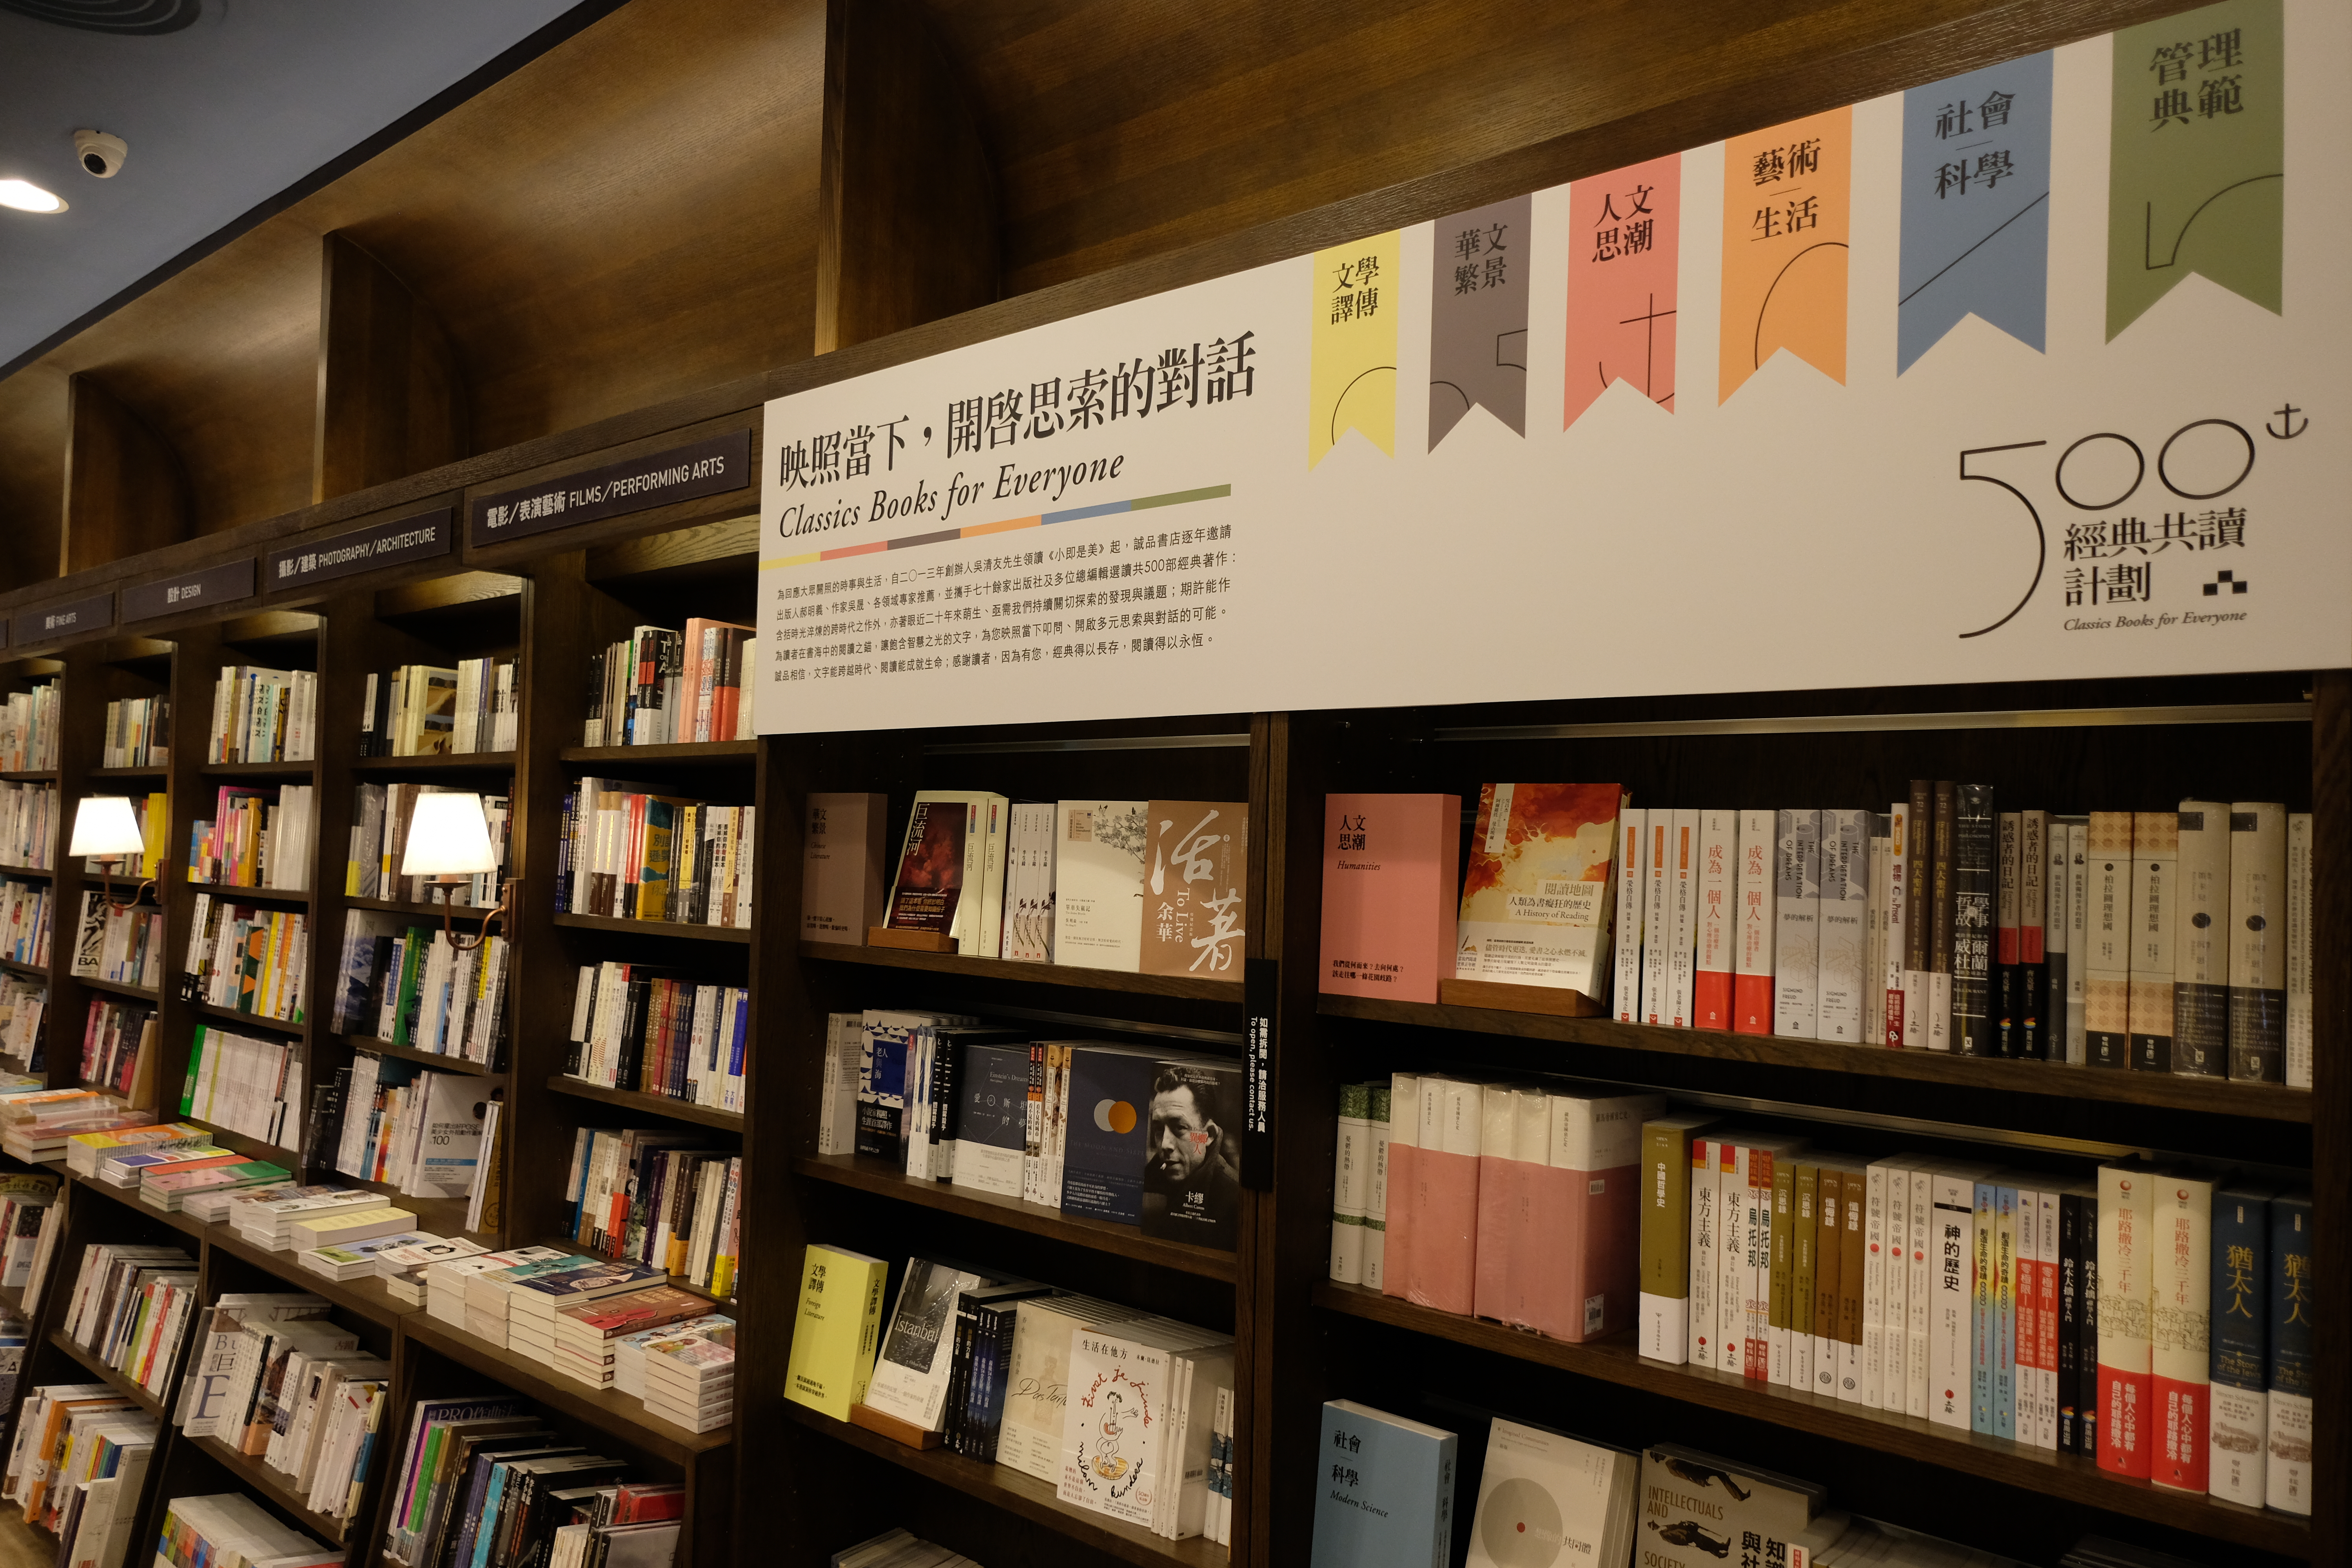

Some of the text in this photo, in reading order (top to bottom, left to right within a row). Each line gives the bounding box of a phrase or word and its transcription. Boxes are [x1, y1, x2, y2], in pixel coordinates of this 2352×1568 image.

[2149, 27, 2243, 86] 管理
[1935, 91, 2016, 140] 社會
[2149, 74, 2244, 132] 典範
[1753, 137, 1821, 187] 藝術
[1934, 149, 2014, 200] 科學
[1594, 185, 1654, 227] 人文
[1751, 196, 1819, 242] 生活
[1455, 223, 1508, 263] 華文
[1592, 219, 1654, 263] 思潮
[1332, 256, 1380, 293] 文學
[1454, 256, 1507, 296] 繁景
[1331, 288, 1379, 325] 譯傳
[570, 464, 689, 509] FILMS/PERFORMING
[692, 456, 724, 480] ARTS
[779, 453, 1125, 538] Classics Books for Everyone
[318, 526, 436, 568] PHOTOGRAPHY/ARCHITECTURE
[1959, 419, 2256, 639] 500
[2063, 507, 2247, 562] 經典共讀
[181, 584, 201, 599] DESIGN
[2063, 562, 2152, 607] 計劃
[66, 612, 76, 624] ARTS
[2063, 610, 2247, 631] Classics Books for Everyone
[906, 803, 930, 856] 巨流河
[1338, 833, 1365, 851] 思潮
[1339, 815, 1366, 831] 人文
[987, 843, 995, 872] 巨流河
[1786, 840, 1793, 851] OF
[2002, 821, 2014, 889] 誘惑者的日記
[2026, 818, 2038, 887] 誘惑者的日記
[1337, 860, 1381, 871] Humanities
[1706, 844, 1723, 919] 成為一個人
[1746, 845, 1763, 922] 成為一個人
[1150, 809, 1246, 972] 活著
[1508, 896, 1591, 911] 人類為書癡狂的歷史
[1544, 882, 1594, 897] 閱讀地圖
[1156, 902, 1175, 943] 余華
[1174, 911, 1190, 943] Live
[1523, 910, 1550, 920] History
[1560, 911, 1590, 922] Reading
[1783, 913, 1813, 922] 夢的解析
[1892, 903, 1901, 924] Present
[1955, 911, 1989, 927] 故事
[1954, 939, 1988, 955] 威爾
[1954, 954, 1988, 971] 杜蘭
[1250, 1016, 1258, 1027] To
[875, 1046, 889, 1059] 老人
[874, 1068, 882, 1081] 海
[990, 1071, 1029, 1083] Einstein's Dreams
[1257, 1017, 1269, 1133] 如需拆閱，請洽服務人員
[433, 1136, 450, 1146] 100
[1084, 1142, 1106, 1150] MOON
[1190, 1132, 1207, 1144] 異鄉
[1193, 1144, 1201, 1155] 人
[1185, 1191, 1204, 1204] 卡繆
[1656, 1162, 1666, 1208] 中國哲學史
[1697, 1188, 1711, 1249] 東方主義
[1726, 1192, 1740, 1254] 東方主義
[1748, 1207, 1757, 1267] 烏托邦
[1871, 1197, 1880, 1242] 符號帝國
[1892, 1200, 1902, 1246] 符號帝國
[1914, 1203, 1925, 1249] 符號帝國
[1760, 1209, 1769, 1269] 烏托邦
[1944, 1224, 1960, 1292] 神的歷史
[2118, 1208, 2132, 1293] 耶路撒冷三千年
[811, 1263, 826, 1278] 文學
[2175, 1218, 2190, 1306] 耶路撒冷三千年
[808, 1277, 824, 1293] 譯傳
[869, 1279, 880, 1315] 文學譯傳
[2227, 1245, 2253, 1318] 猶太人
[2284, 1253, 2312, 1328] 猶太人
[806, 1297, 821, 1309] Foreign
[895, 1315, 940, 1343] Istanbul
[1020, 1316, 1027, 1334] 香水
[1082, 1339, 1129, 1360] 生活在他方
[1502, 1427, 1521, 1438] Imagined
[2111, 1380, 2122, 1448] 自己的耶路撒冷
[2124, 1383, 2136, 1452] 每個人心中都有
[2167, 1391, 2178, 1459] 自己的耶路撒冷
[2180, 1394, 2193, 1464] 每個人心中都有
[1334, 1430, 1361, 1454] 社會
[1332, 1465, 1359, 1488] 科學
[1330, 1491, 1389, 1519] Modern Science
[1647, 1501, 1669, 1519] AND
[1648, 1485, 1724, 1521] INTELLECTUALS
